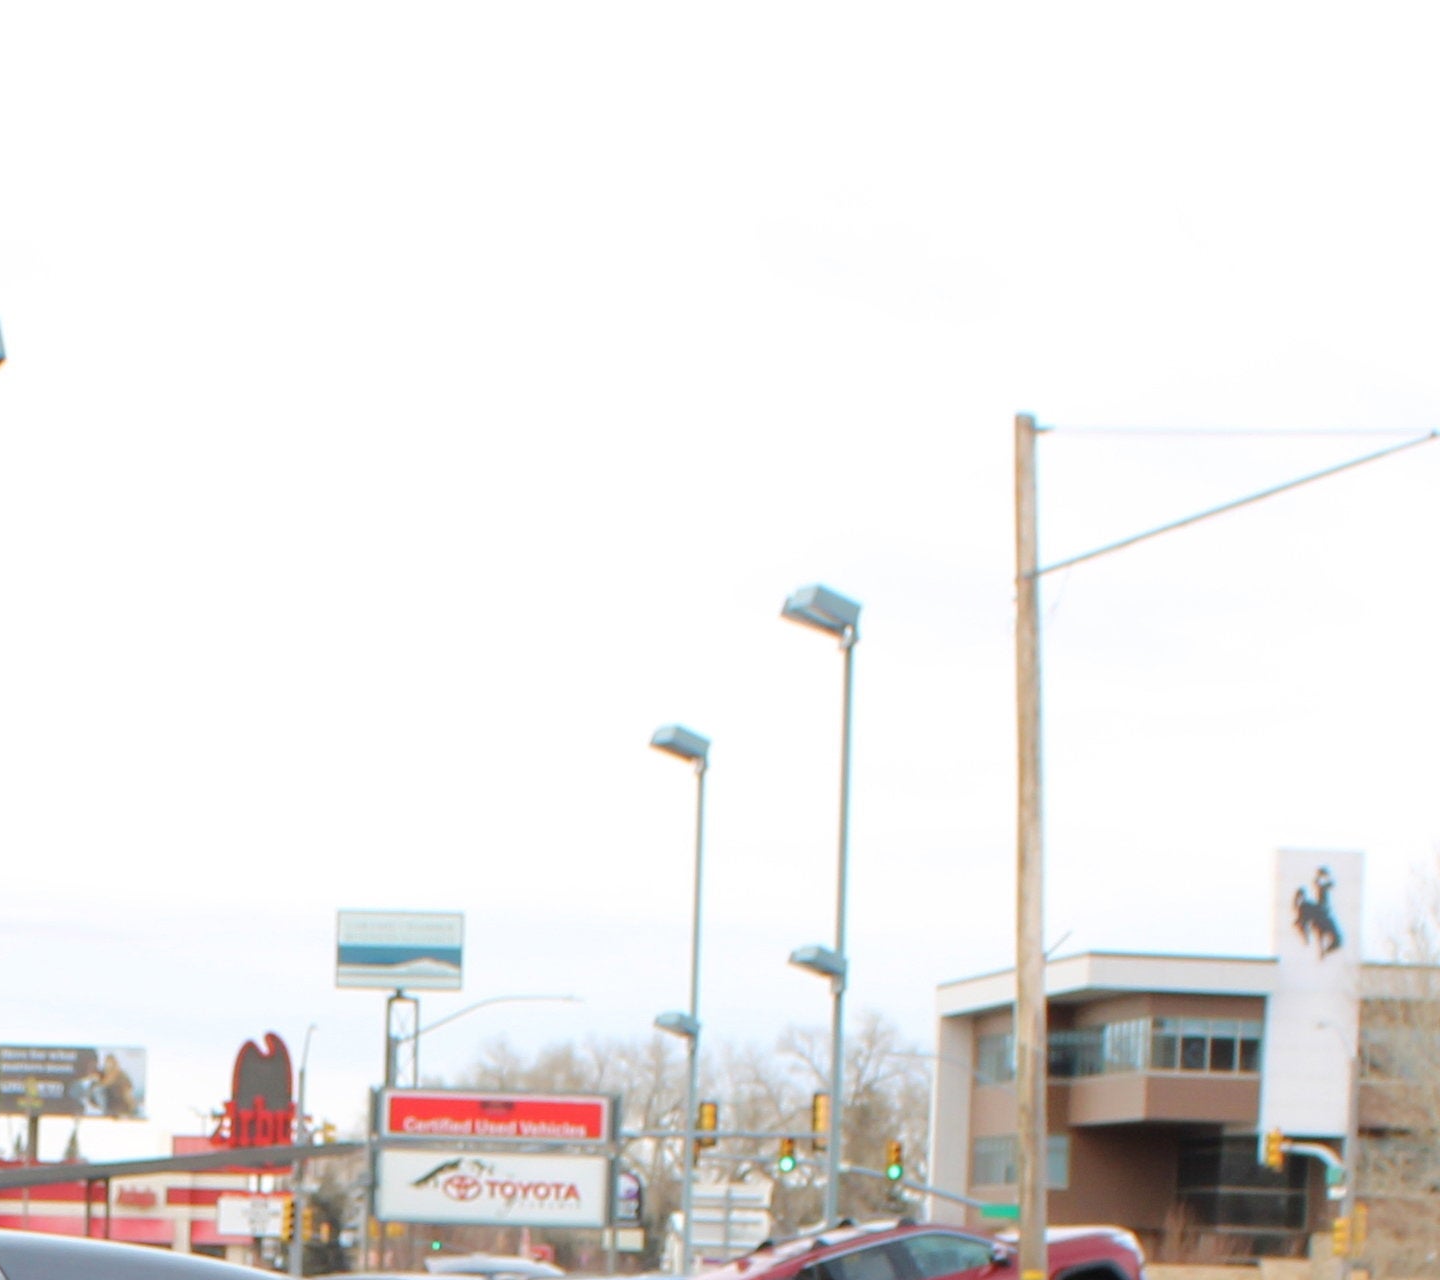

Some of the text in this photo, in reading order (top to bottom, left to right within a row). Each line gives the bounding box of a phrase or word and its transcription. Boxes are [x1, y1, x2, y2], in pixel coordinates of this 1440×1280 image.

[402, 1115, 588, 1138] Certified Used Vehicles
[484, 1178, 581, 1201] TOYOTA
